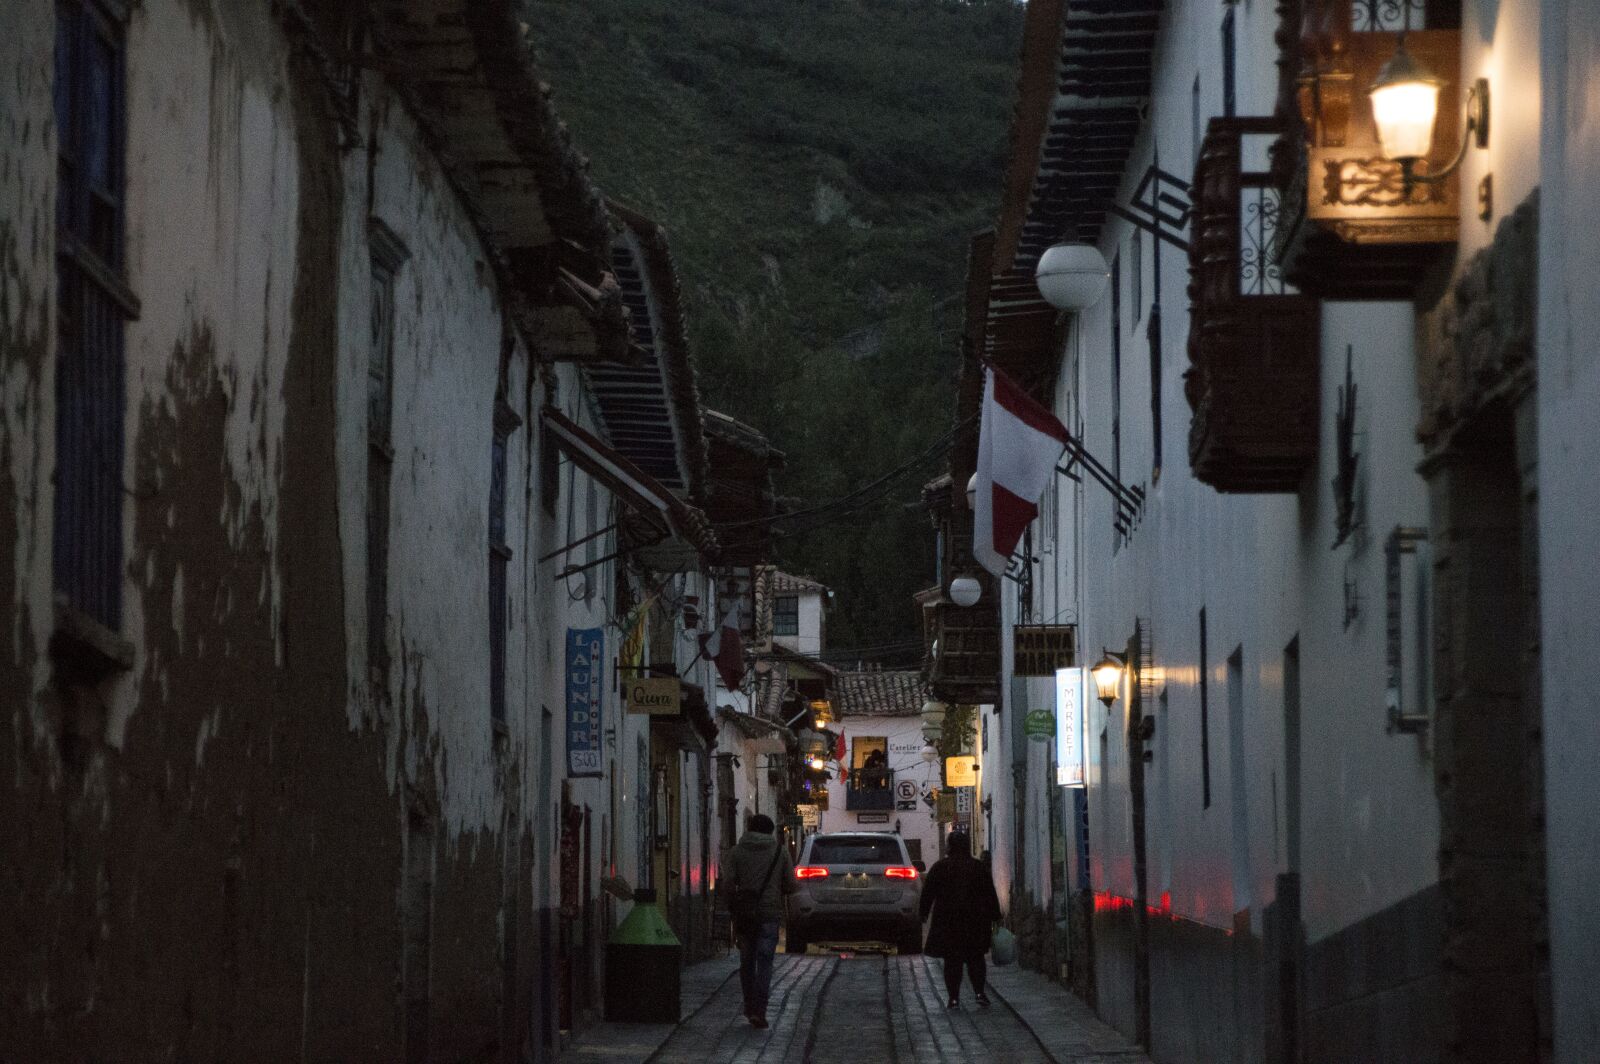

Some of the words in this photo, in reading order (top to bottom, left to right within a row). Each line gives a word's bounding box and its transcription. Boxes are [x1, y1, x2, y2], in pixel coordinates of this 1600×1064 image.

[572, 633, 590, 743] LAUNDR
[1063, 688, 1075, 756] MARKET
[889, 743, 921, 751] L'atelier
